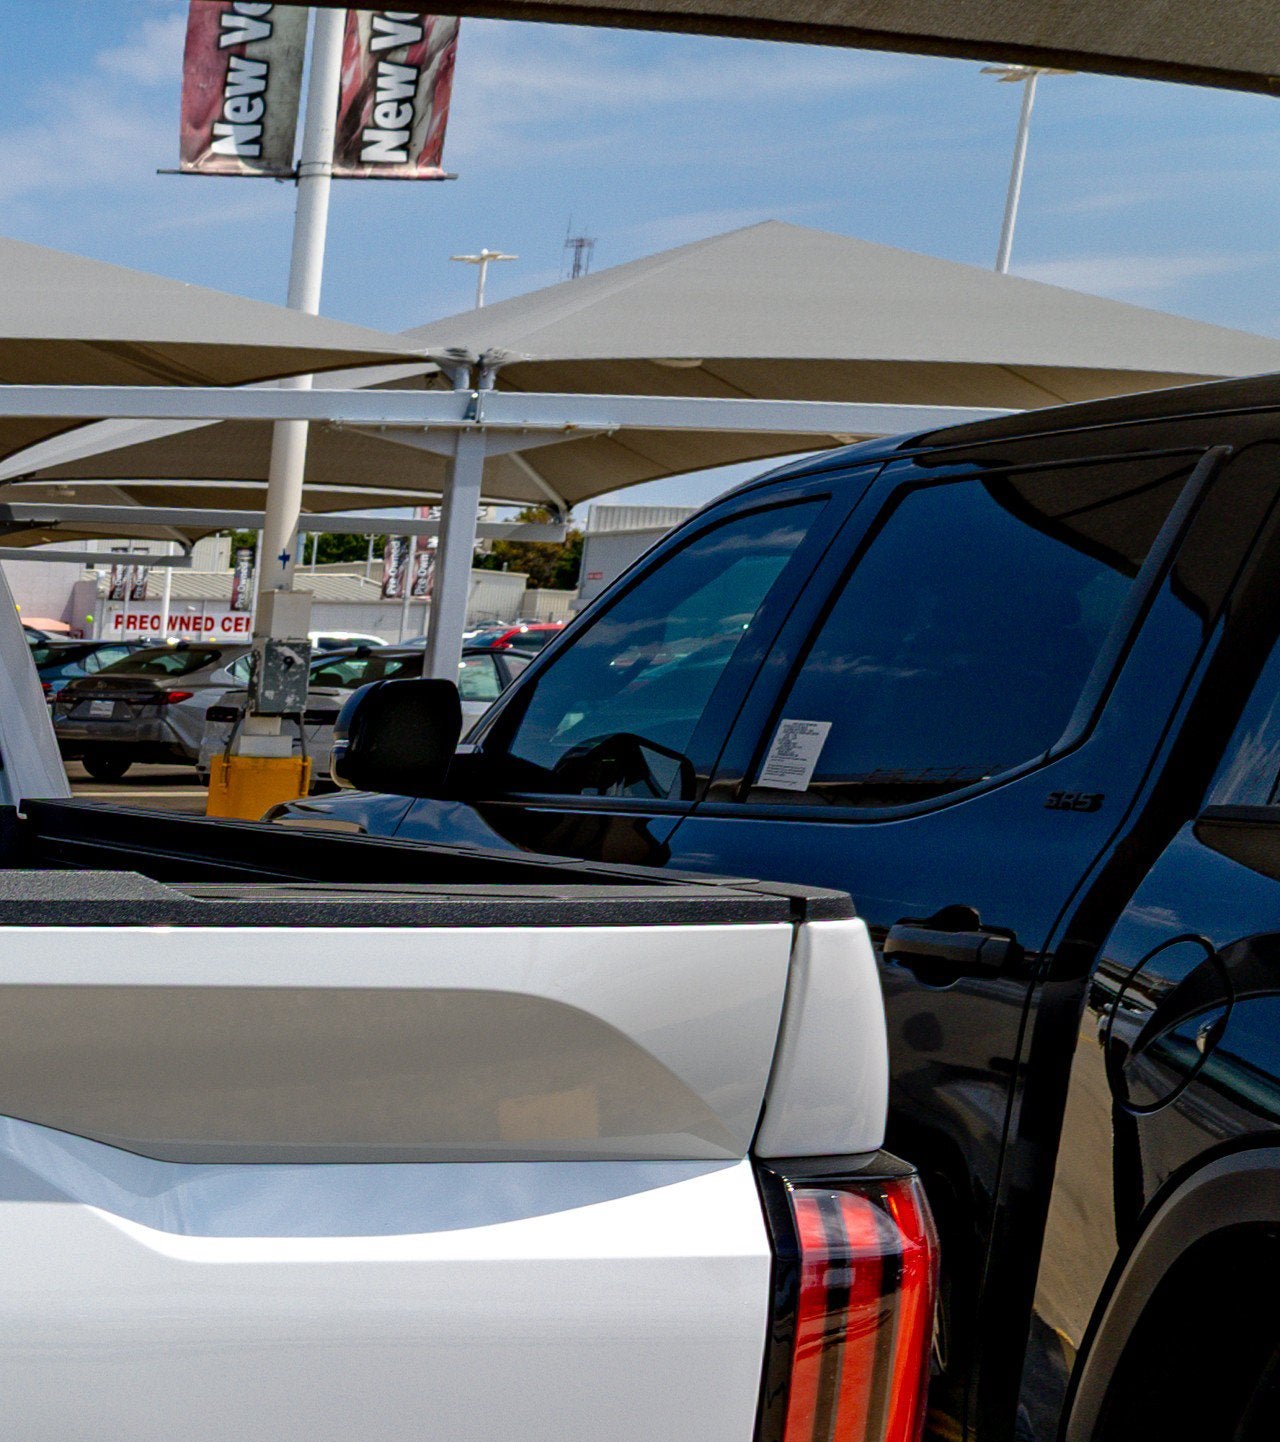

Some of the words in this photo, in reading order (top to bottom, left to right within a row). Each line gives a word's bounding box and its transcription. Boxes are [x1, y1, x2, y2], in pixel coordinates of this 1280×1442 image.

[211, 57, 269, 157] New
[359, 61, 419, 163] New
[115, 614, 215, 632] PREOWNED
